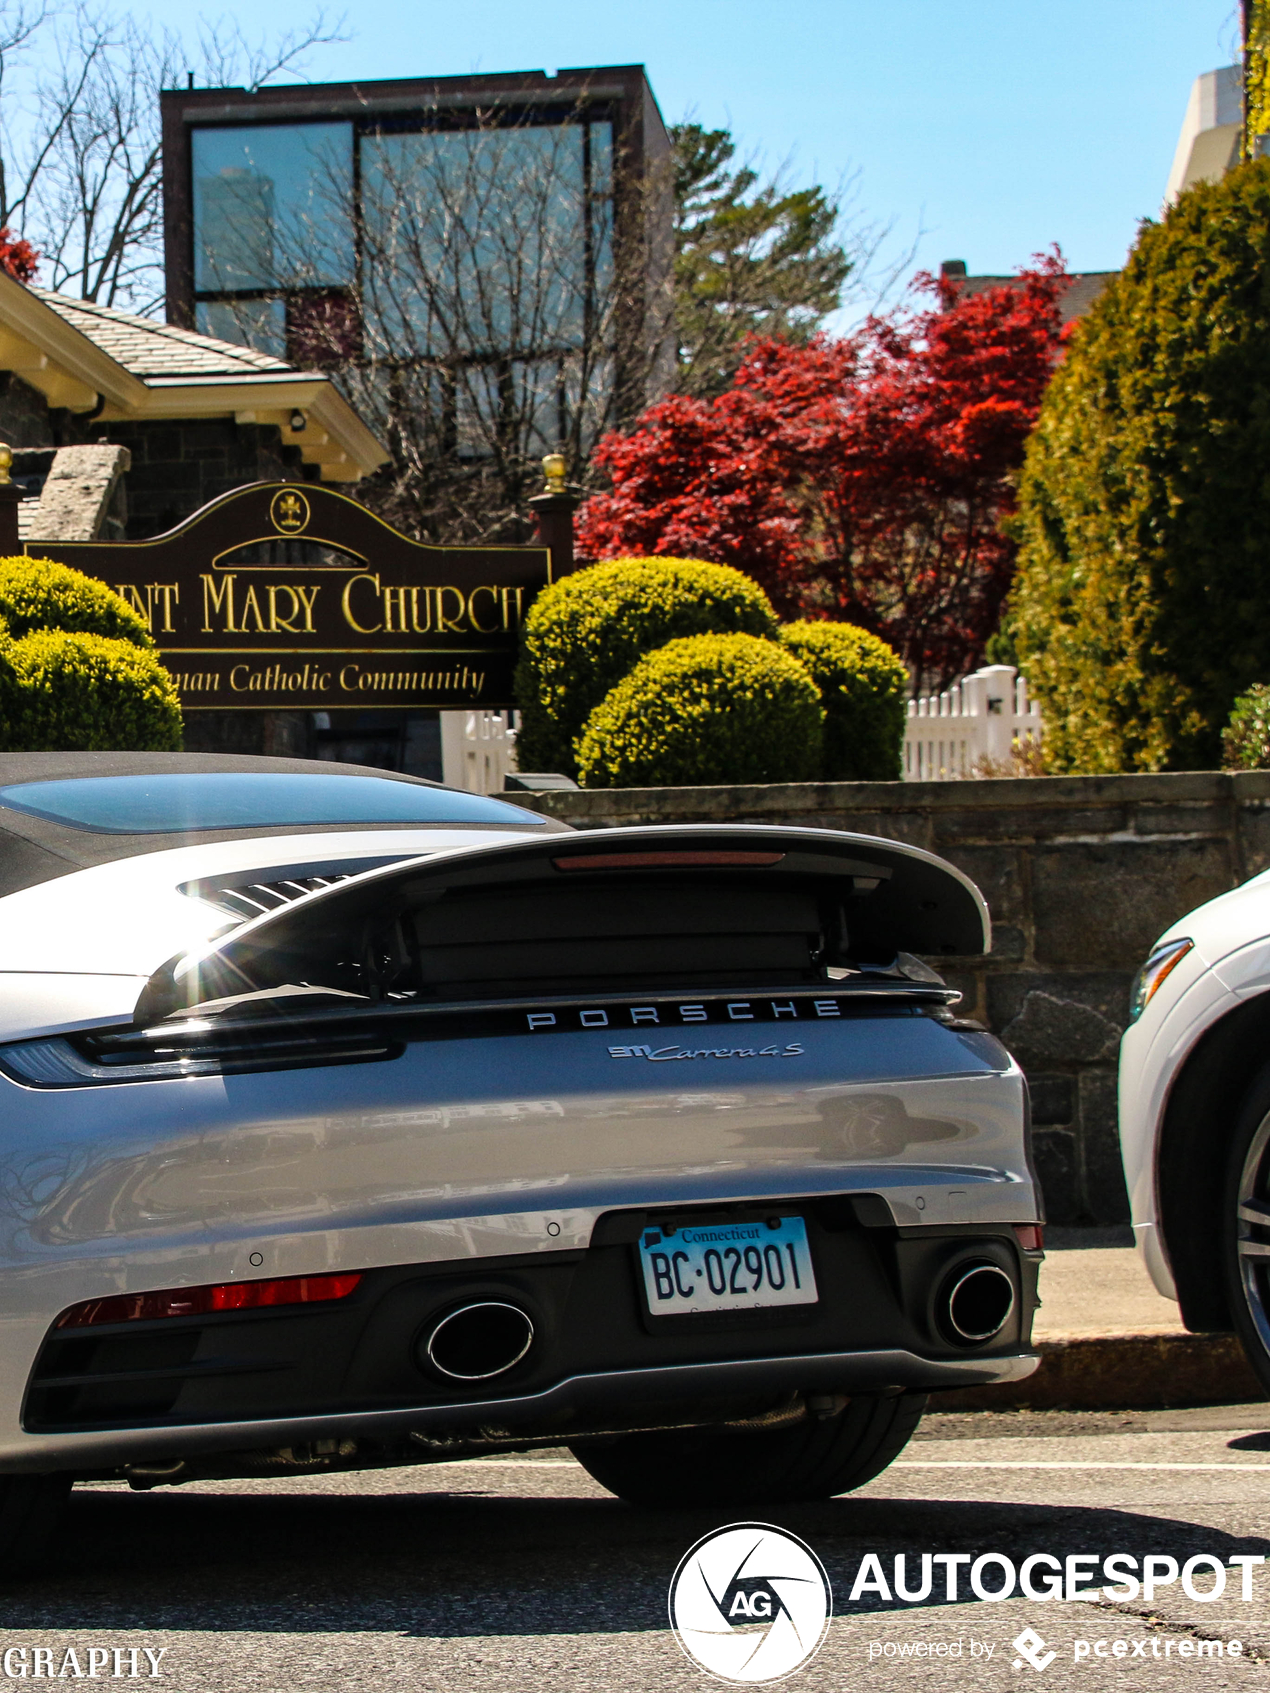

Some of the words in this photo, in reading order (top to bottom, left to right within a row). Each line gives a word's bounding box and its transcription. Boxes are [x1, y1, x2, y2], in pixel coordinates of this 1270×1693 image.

[199, 574, 321, 633] MARY
[342, 573, 525, 634] CHURCH
[169, 672, 220, 692] man
[230, 664, 331, 692] Catholic
[339, 664, 485, 698] Community
[527, 1000, 841, 1030] PORSCHE
[682, 1227, 760, 1244] Connecticut
